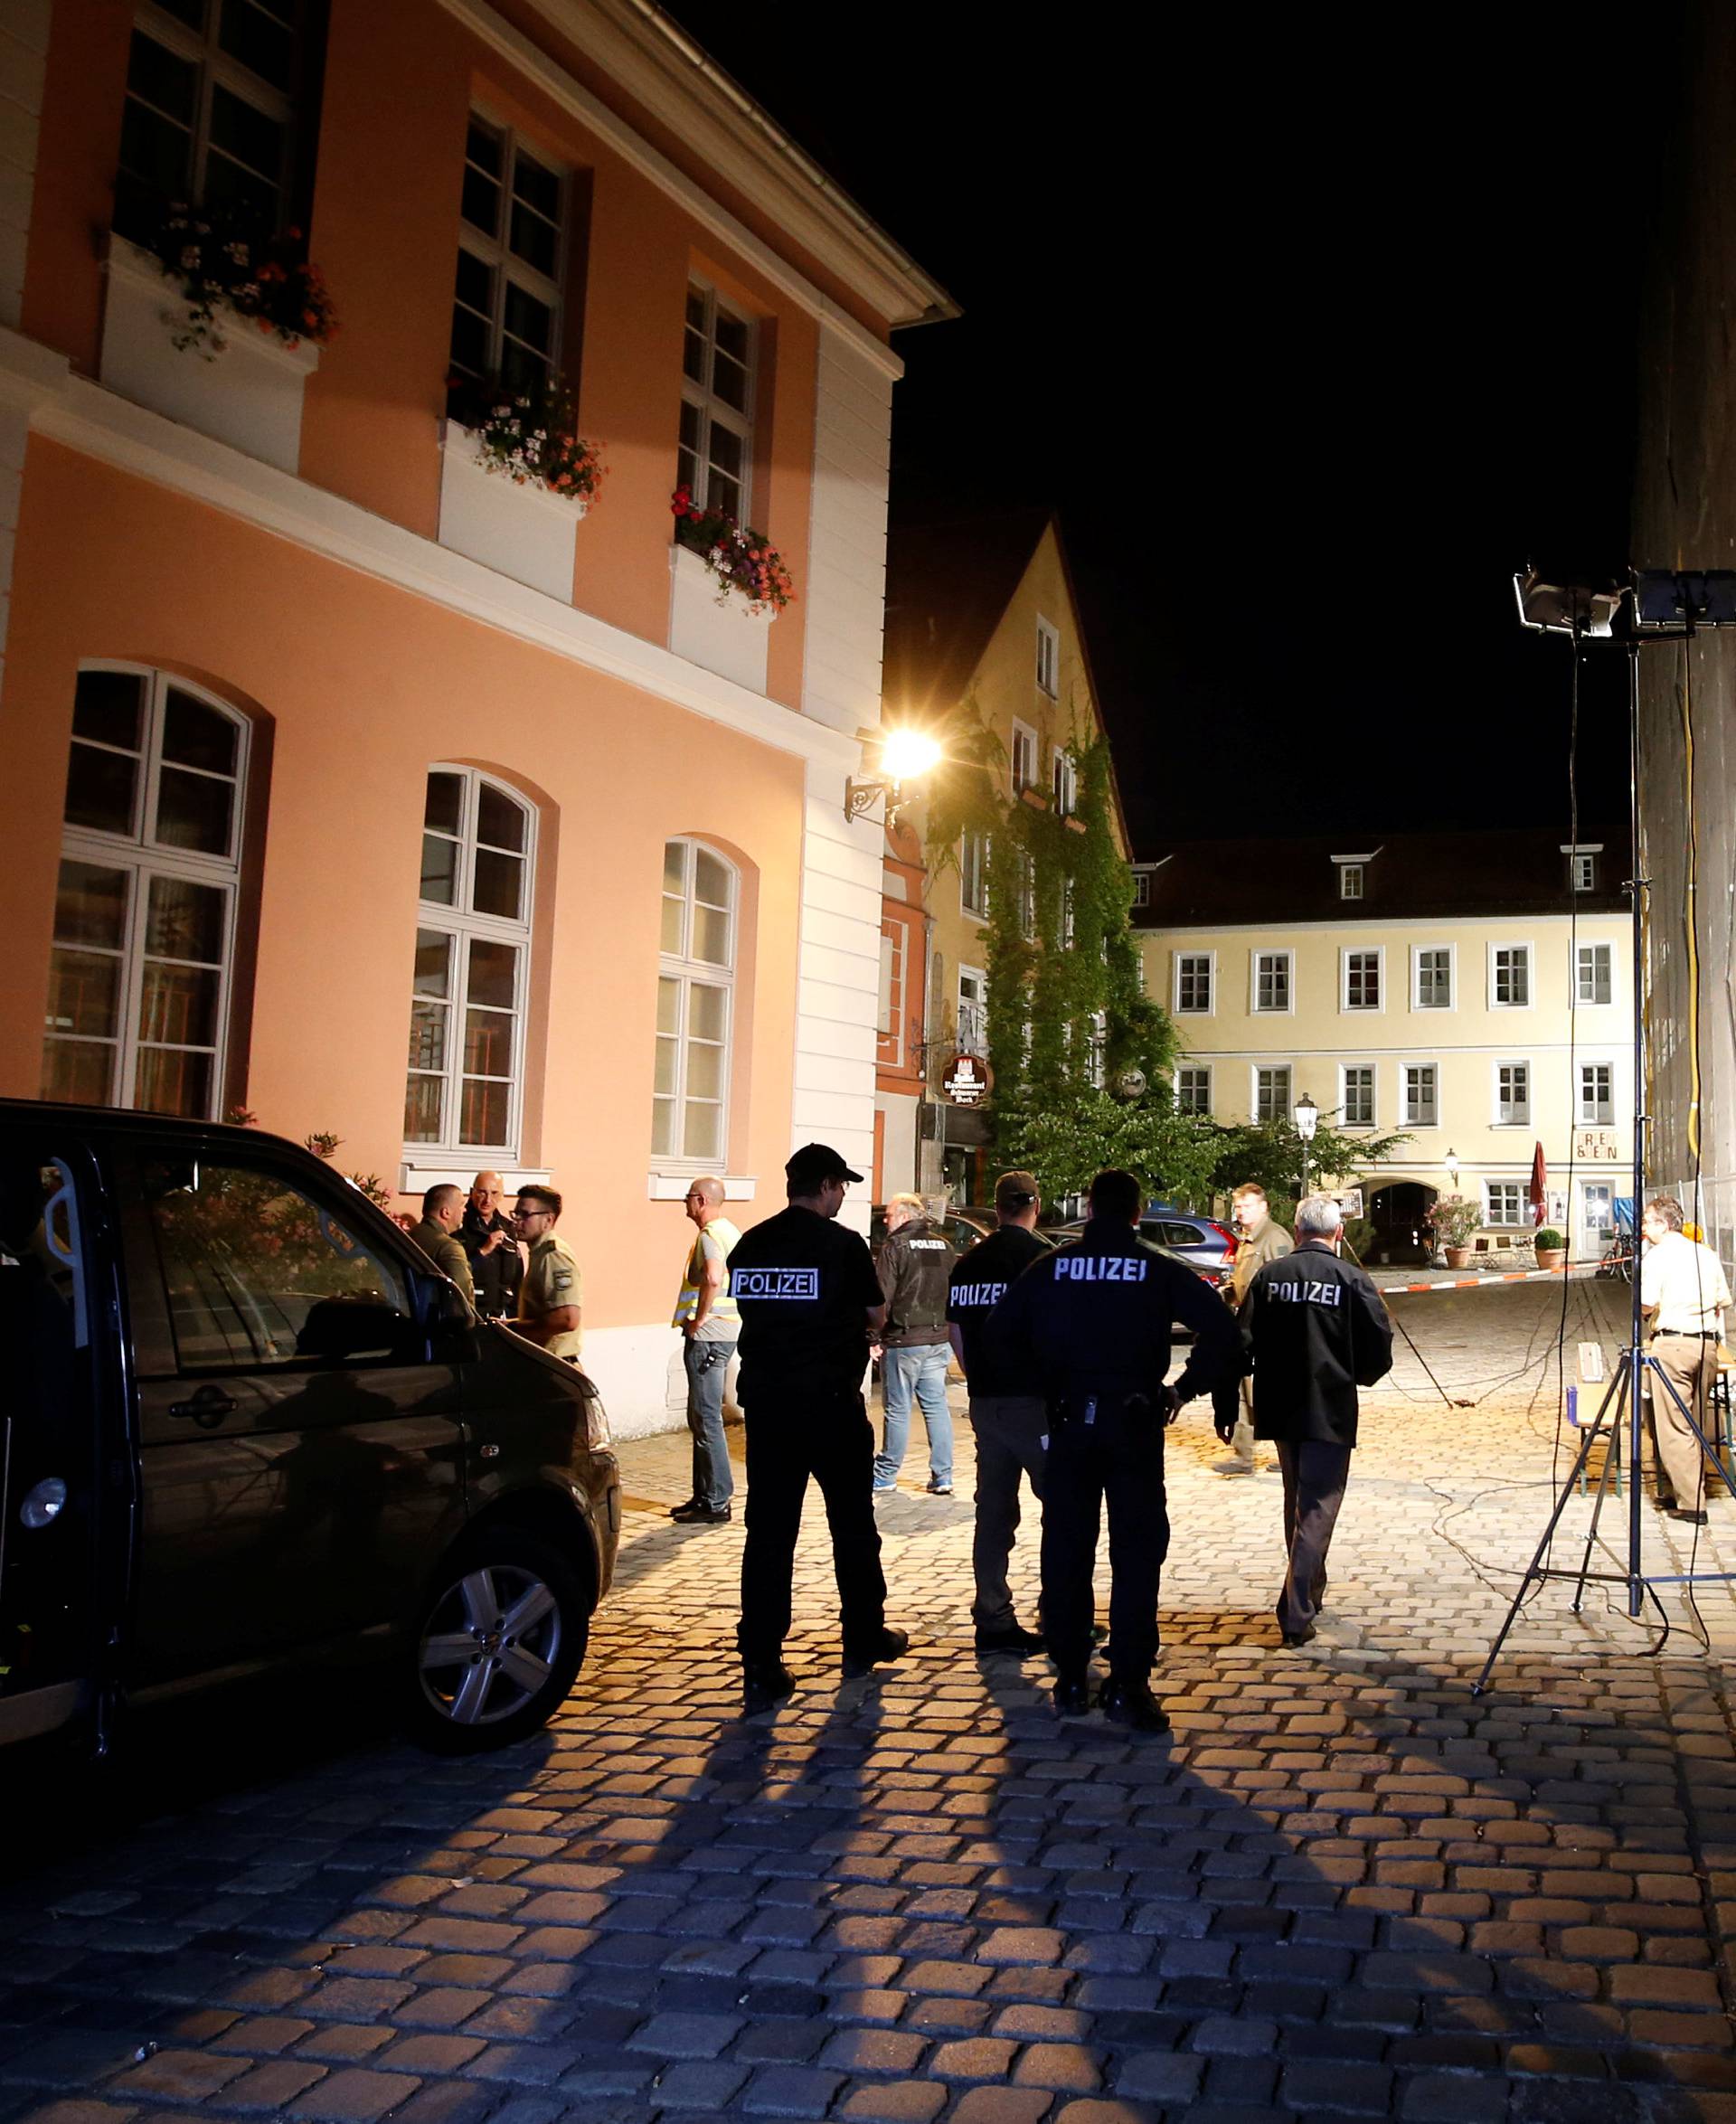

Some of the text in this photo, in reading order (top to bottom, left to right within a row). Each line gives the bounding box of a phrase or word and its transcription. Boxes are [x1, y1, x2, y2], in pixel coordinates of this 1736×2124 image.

[909, 1239, 947, 1250] POLIZEI
[1054, 1257, 1147, 1281] POLIZEI
[736, 1273, 814, 1294] POLIZEI
[1267, 1281, 1341, 1307] POLIZEI
